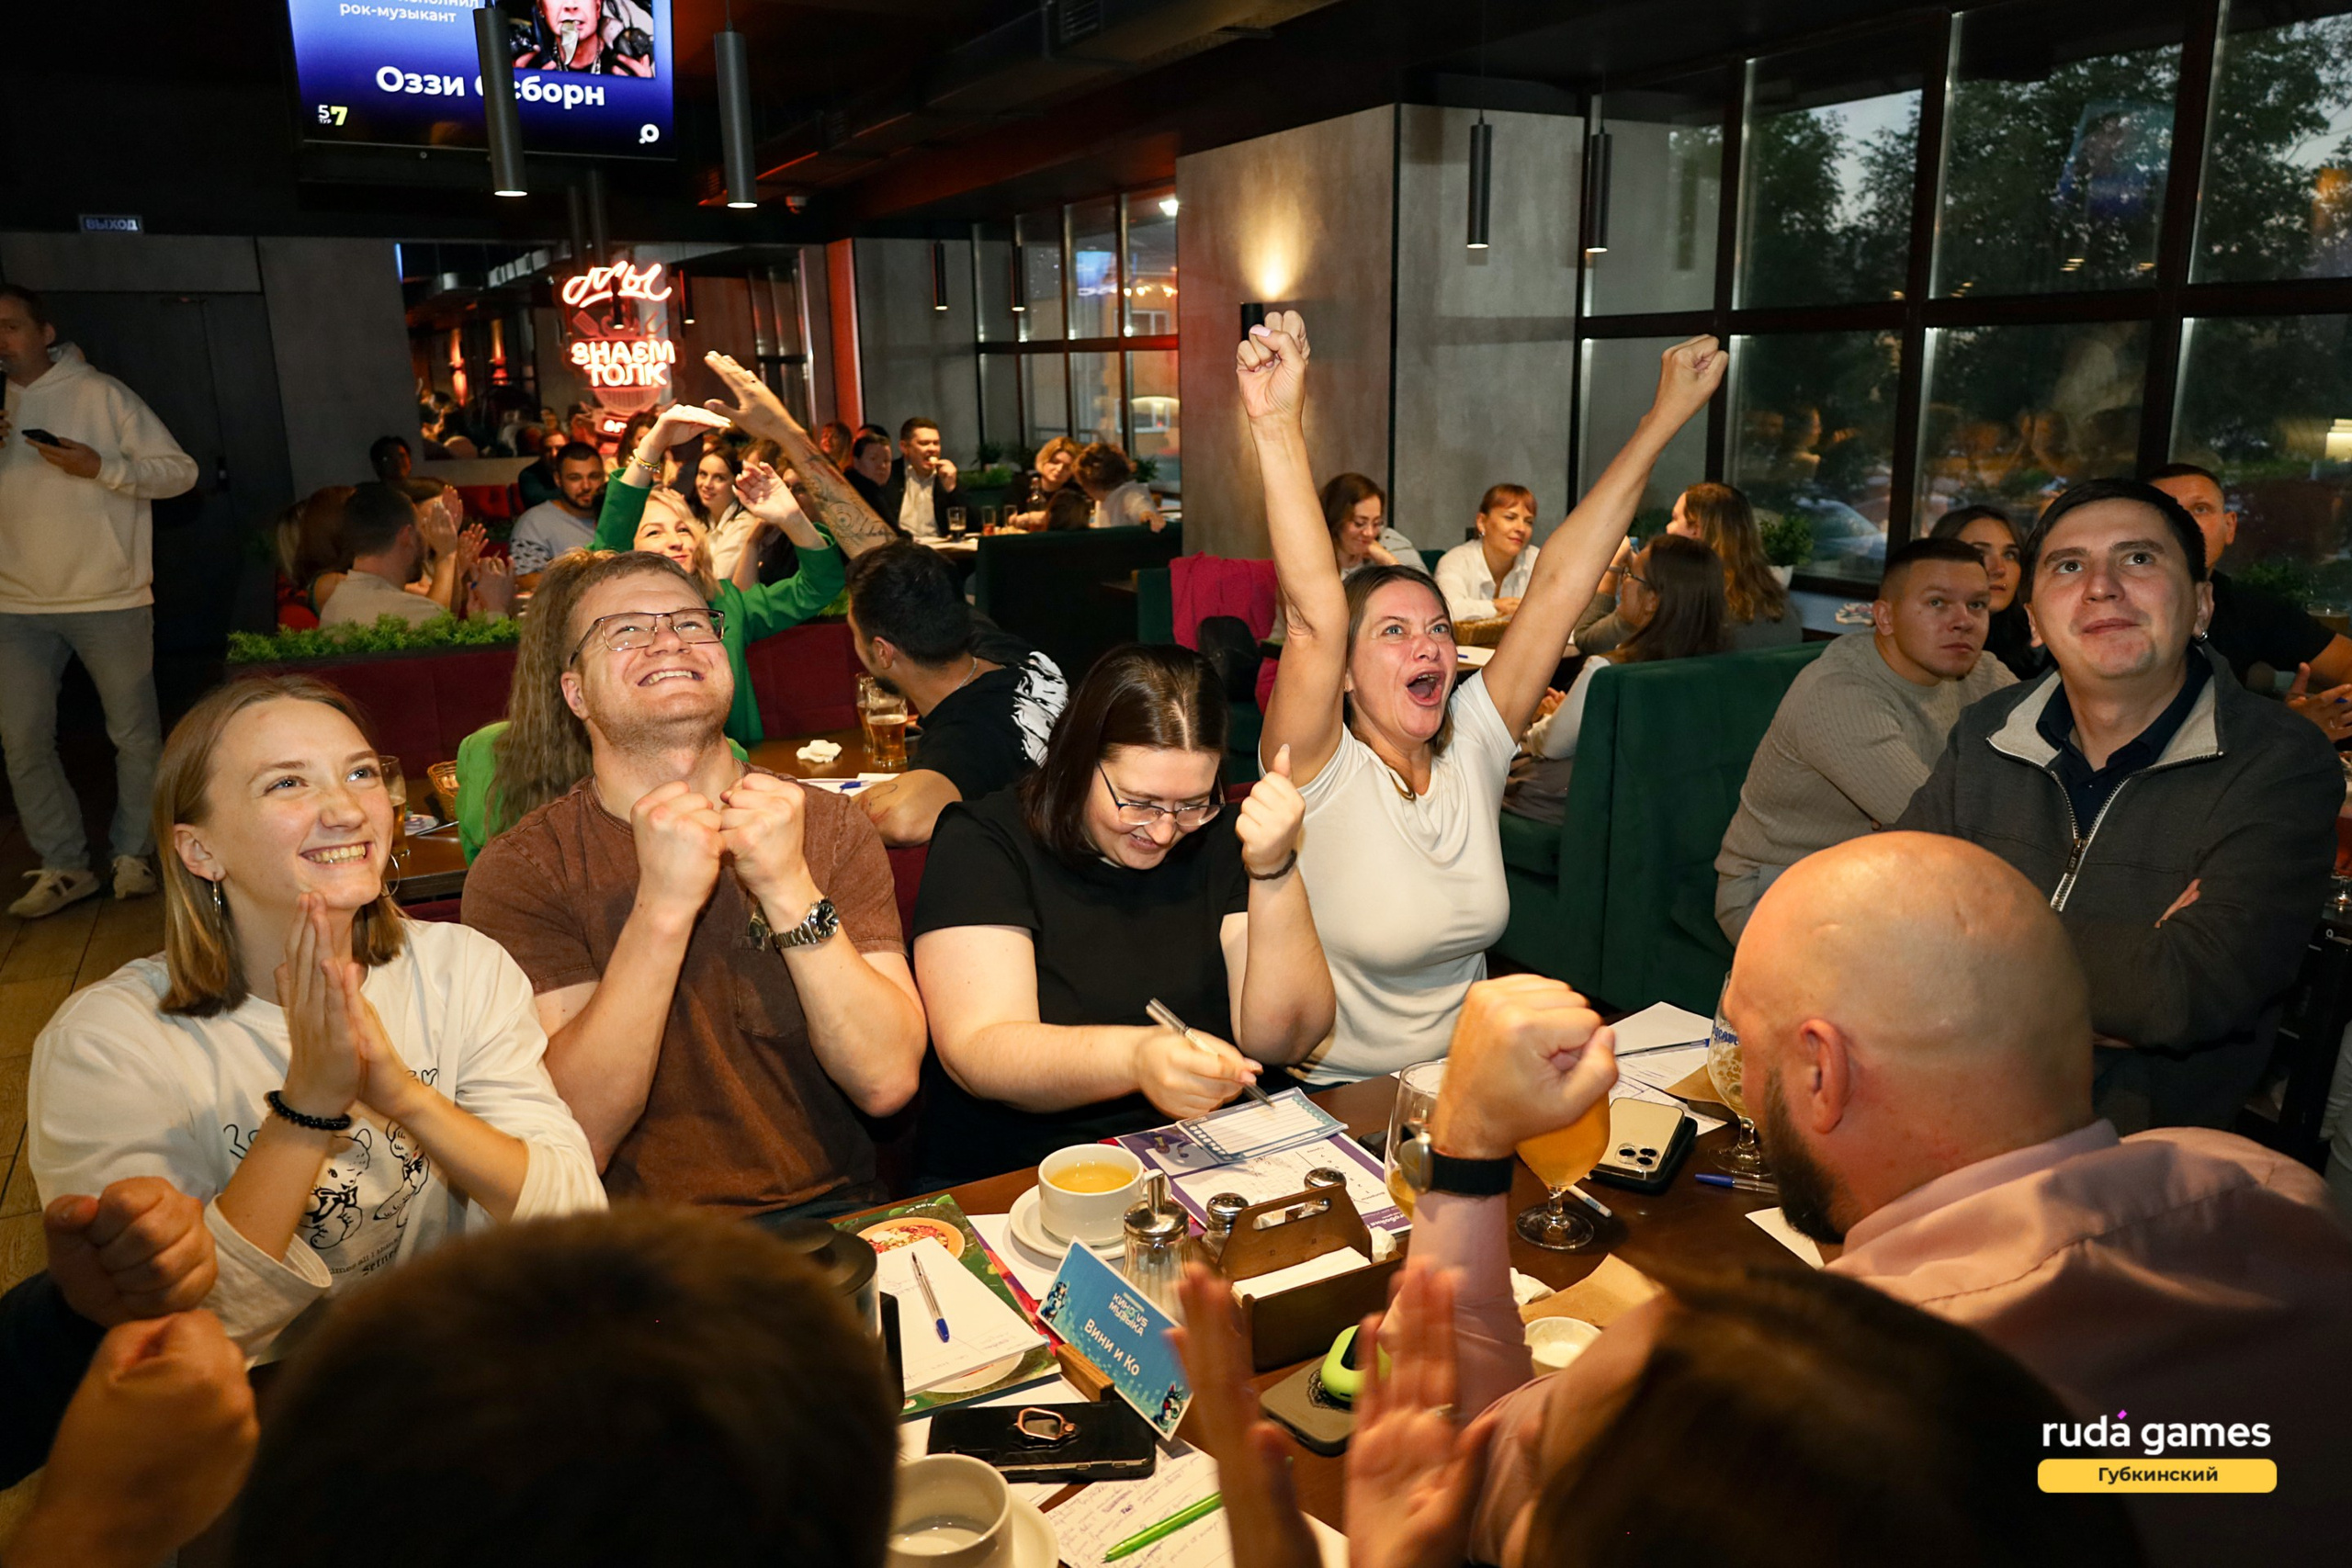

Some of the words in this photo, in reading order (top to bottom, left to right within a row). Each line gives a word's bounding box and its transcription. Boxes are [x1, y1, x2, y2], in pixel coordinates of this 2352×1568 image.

[339, 3, 457, 23] рок-музыкант
[375, 65, 465, 97] Оззи
[85, 218, 139, 231] ВЫХОД
[571, 339, 675, 366] ЗНАЕМ
[583, 362, 667, 387] ТОЛК
[1107, 1302, 1146, 1337] МУЗЫКА
[1083, 1318, 1114, 1353] Вини
[1113, 1347, 1124, 1362] и
[1123, 1354, 1140, 1376] Ко
